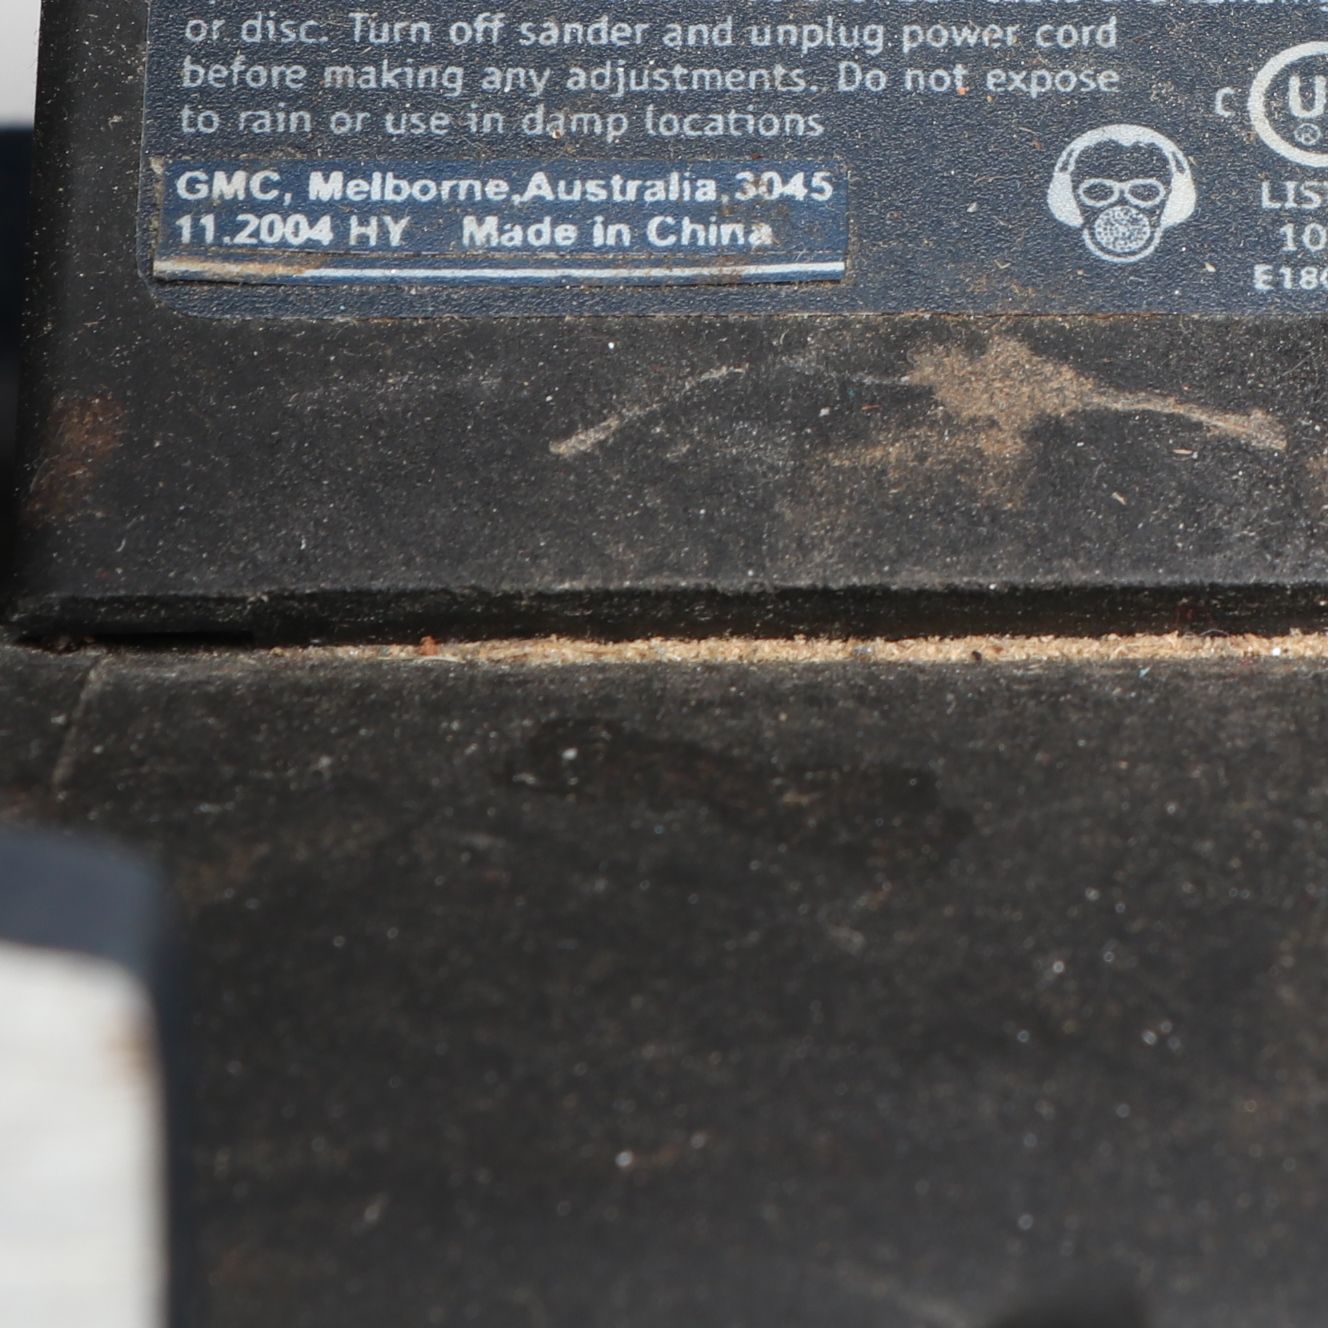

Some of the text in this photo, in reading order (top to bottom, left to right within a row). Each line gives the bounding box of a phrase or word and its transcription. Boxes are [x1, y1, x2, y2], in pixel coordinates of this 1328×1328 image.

[186, 11, 1117, 54] or disc. Turn off sander and unplug power cord
[183, 56, 1119, 99] before making any adjustments. Do not expose
[182, 103, 824, 141] to rain or use in damp locations
[176, 171, 291, 205] GMC,
[176, 214, 773, 248] 11.2004 HY Made in China
